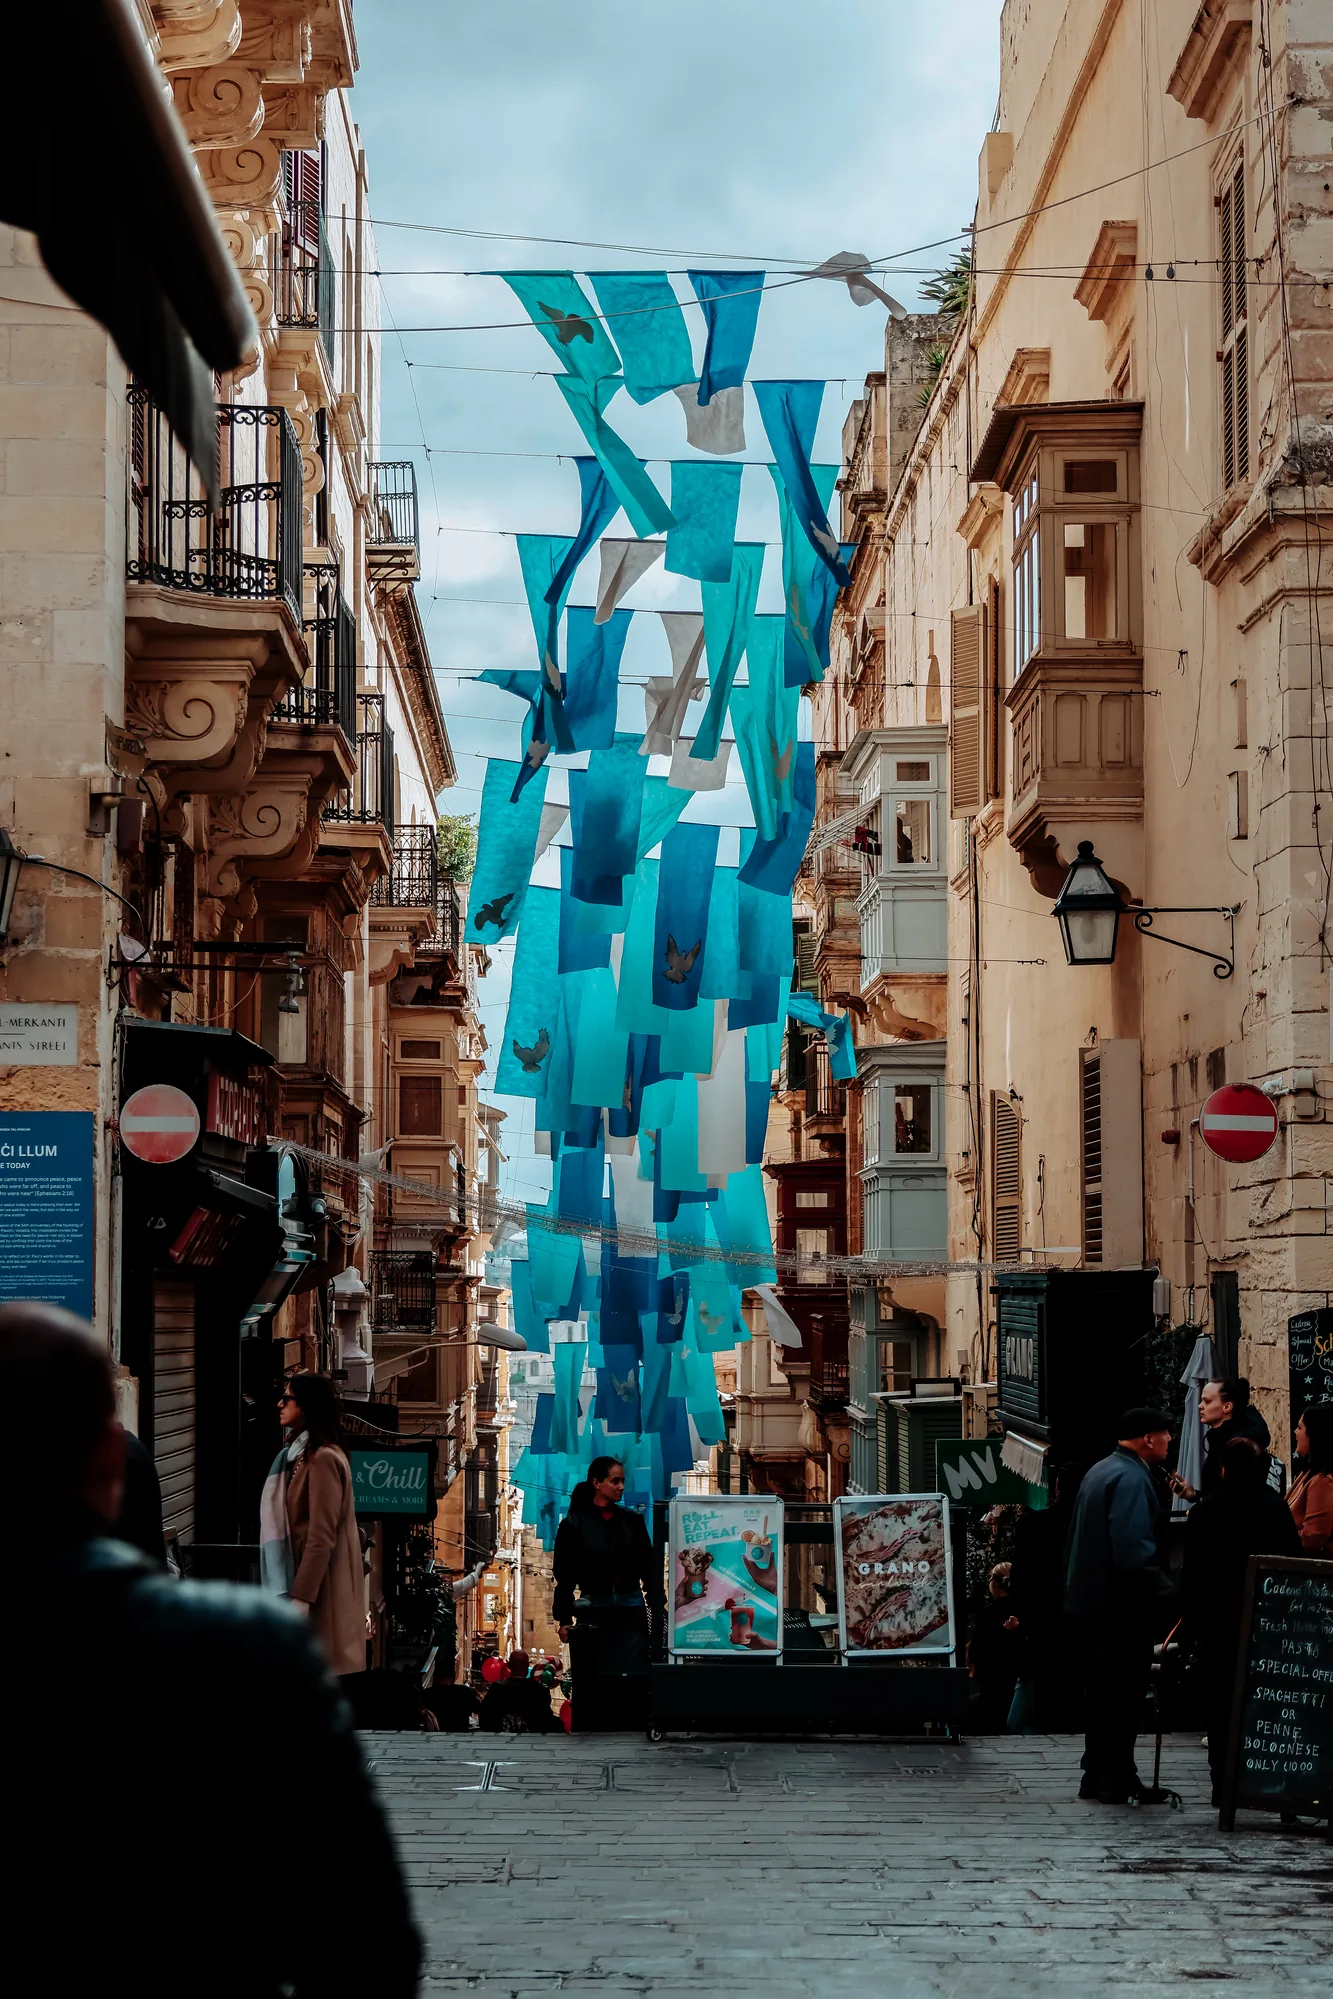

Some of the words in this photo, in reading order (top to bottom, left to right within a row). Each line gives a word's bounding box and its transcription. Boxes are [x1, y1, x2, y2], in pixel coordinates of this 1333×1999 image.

[0, 1143, 14, 1157] ĊI
[18, 1145, 58, 1157] LLUM
[1005, 1336, 1034, 1382] GRANO
[355, 1472, 365, 1484] &
[363, 1459, 426, 1490] Chill
[401, 1496, 426, 1504] MORE
[858, 1561, 931, 1576] GRANO
[1263, 1577, 1301, 1596] Cadena
[1260, 1617, 1288, 1632] Fresh
[1281, 1639, 1320, 1658] PASTA
[1257, 1659, 1310, 1678] SPECIAL
[1253, 1686, 1326, 1708] SPAGHETTI
[1282, 1708, 1296, 1720] OR
[1256, 1720, 1302, 1742] PENNE
[1244, 1736, 1320, 1757] BOLOGNESE
[1246, 1758, 1279, 1772] ONLY
